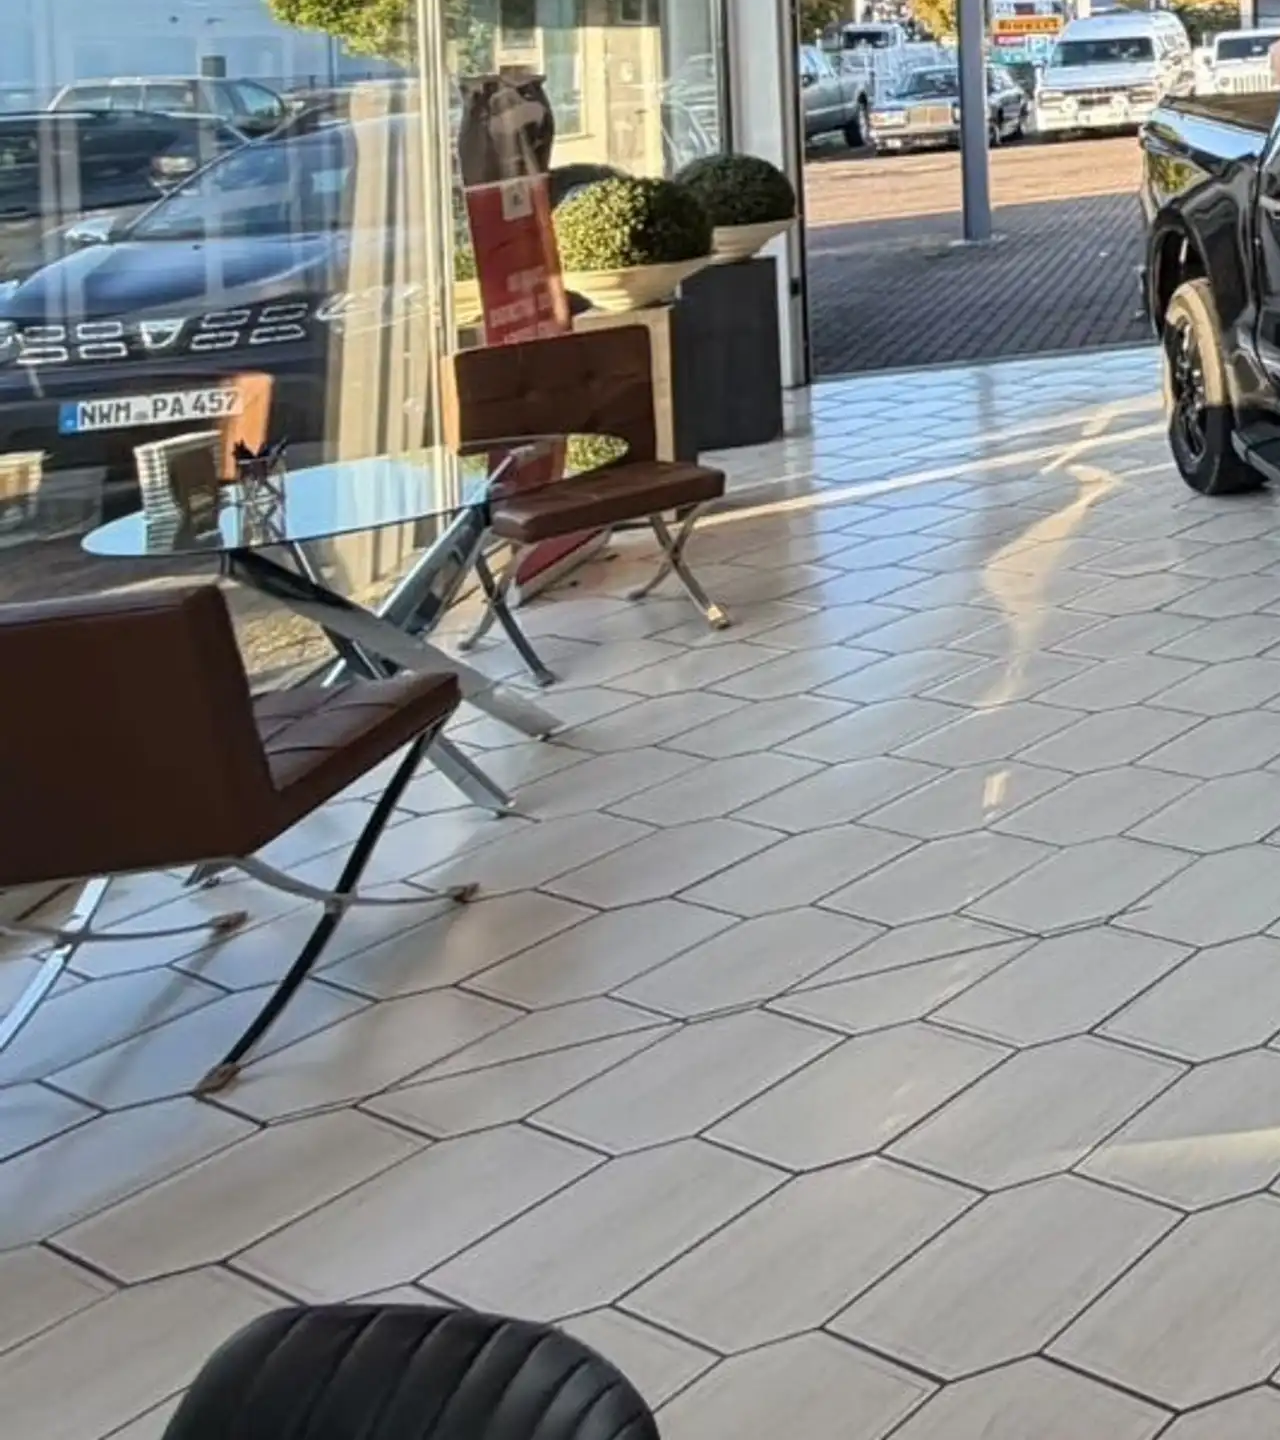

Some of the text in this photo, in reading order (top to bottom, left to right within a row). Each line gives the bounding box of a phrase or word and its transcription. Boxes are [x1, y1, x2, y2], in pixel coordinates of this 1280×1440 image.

[79, 391, 239, 426] NWM PA 457
